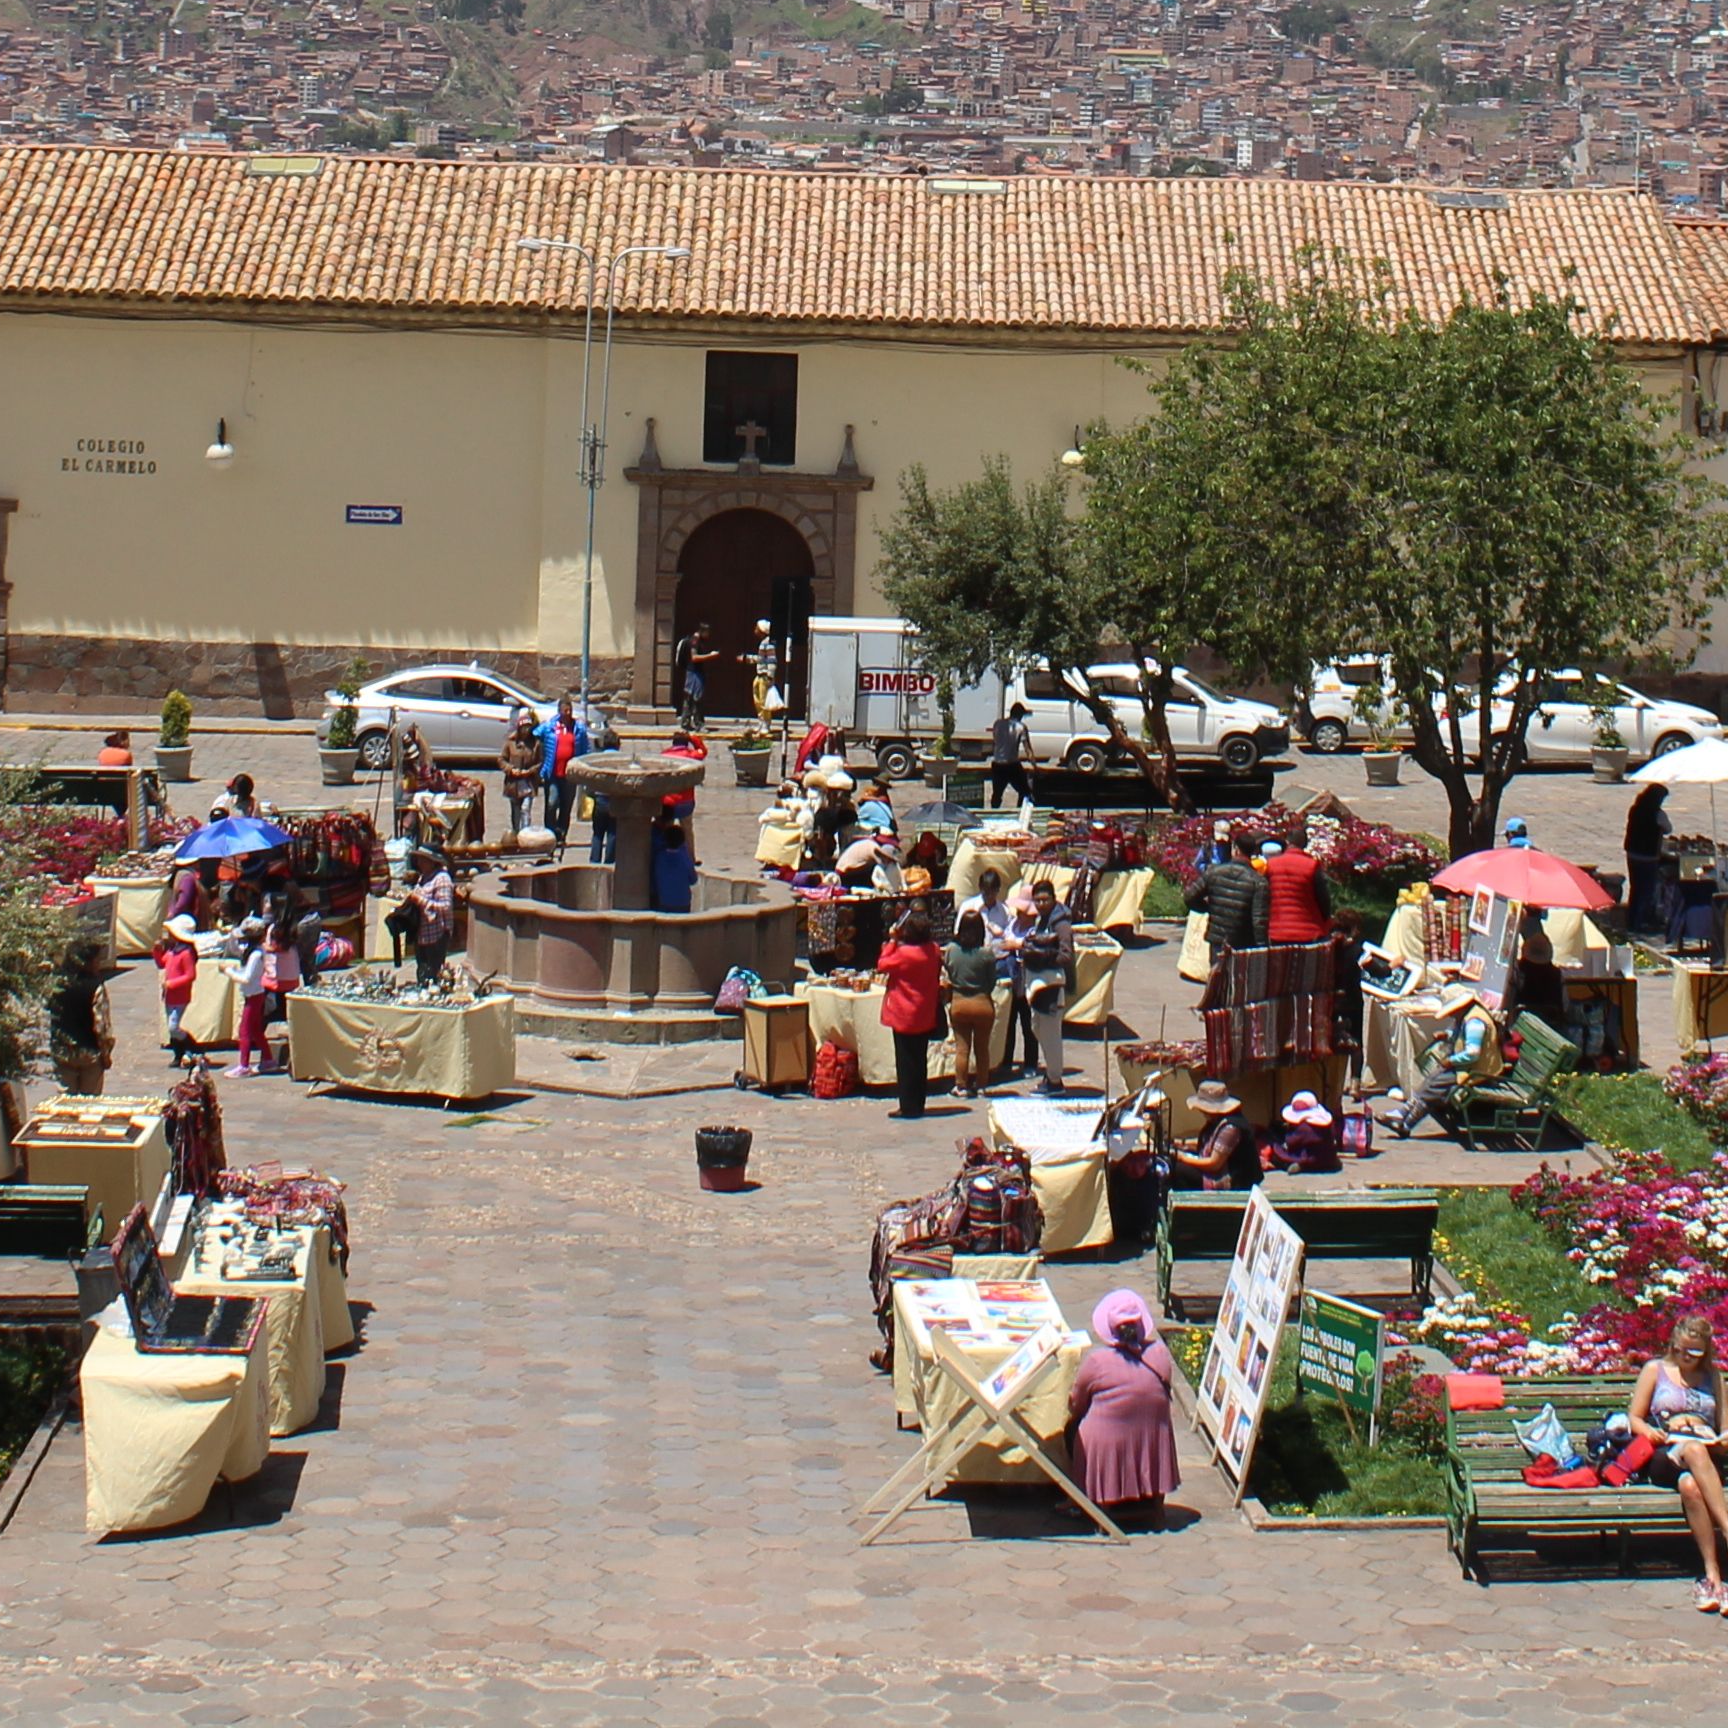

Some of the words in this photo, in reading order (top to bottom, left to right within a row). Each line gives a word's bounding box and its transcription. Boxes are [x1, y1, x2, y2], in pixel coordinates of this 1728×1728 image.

[77, 438, 146, 454] COLEGIO
[61, 458, 80, 472] EL
[85, 459, 157, 474] CARMELO
[859, 673, 936, 692] BIMBO
[1302, 1325, 1314, 1342] LOS
[1343, 1339, 1355, 1358] SON
[1338, 1355, 1354, 1376] VIDA
